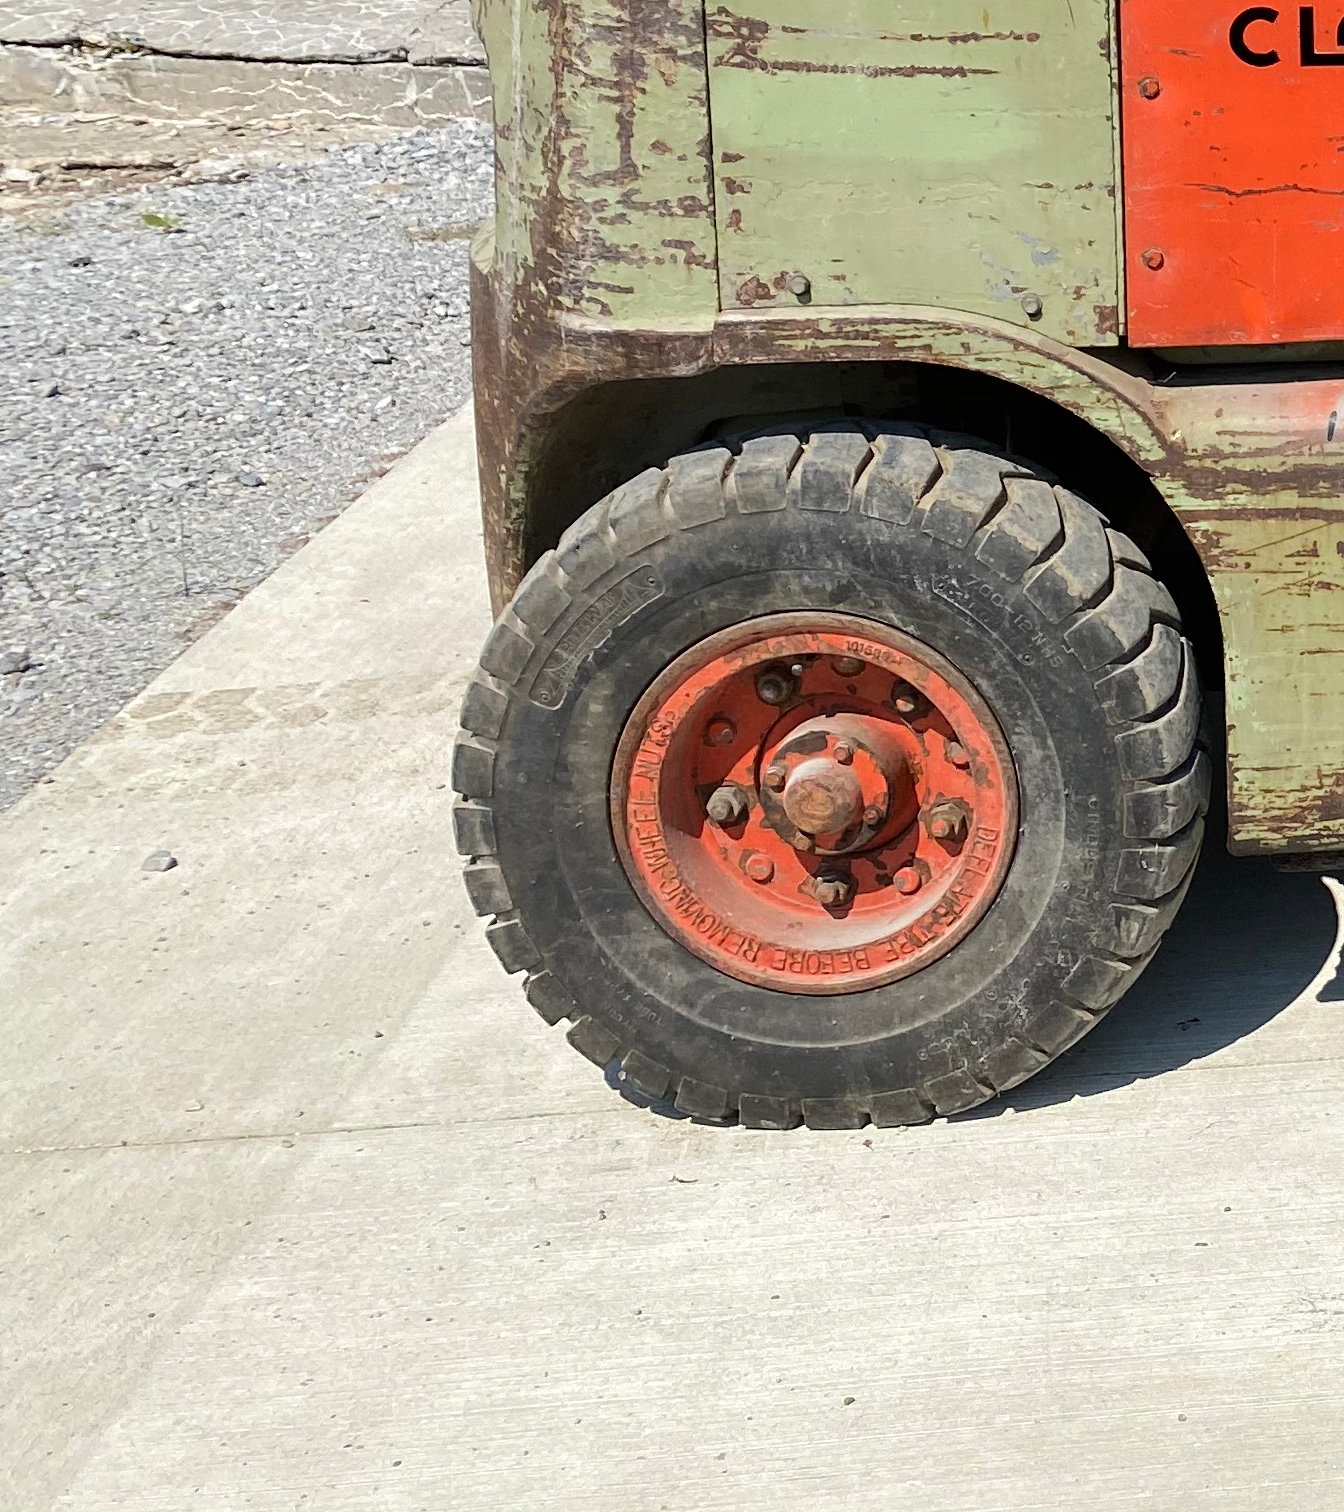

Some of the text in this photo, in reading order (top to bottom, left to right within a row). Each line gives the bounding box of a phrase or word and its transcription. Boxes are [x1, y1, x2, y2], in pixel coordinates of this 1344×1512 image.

[631, 790, 669, 874] WHEEL
[659, 878, 763, 964] REMOVING
[771, 946, 872, 975] BEFORE
